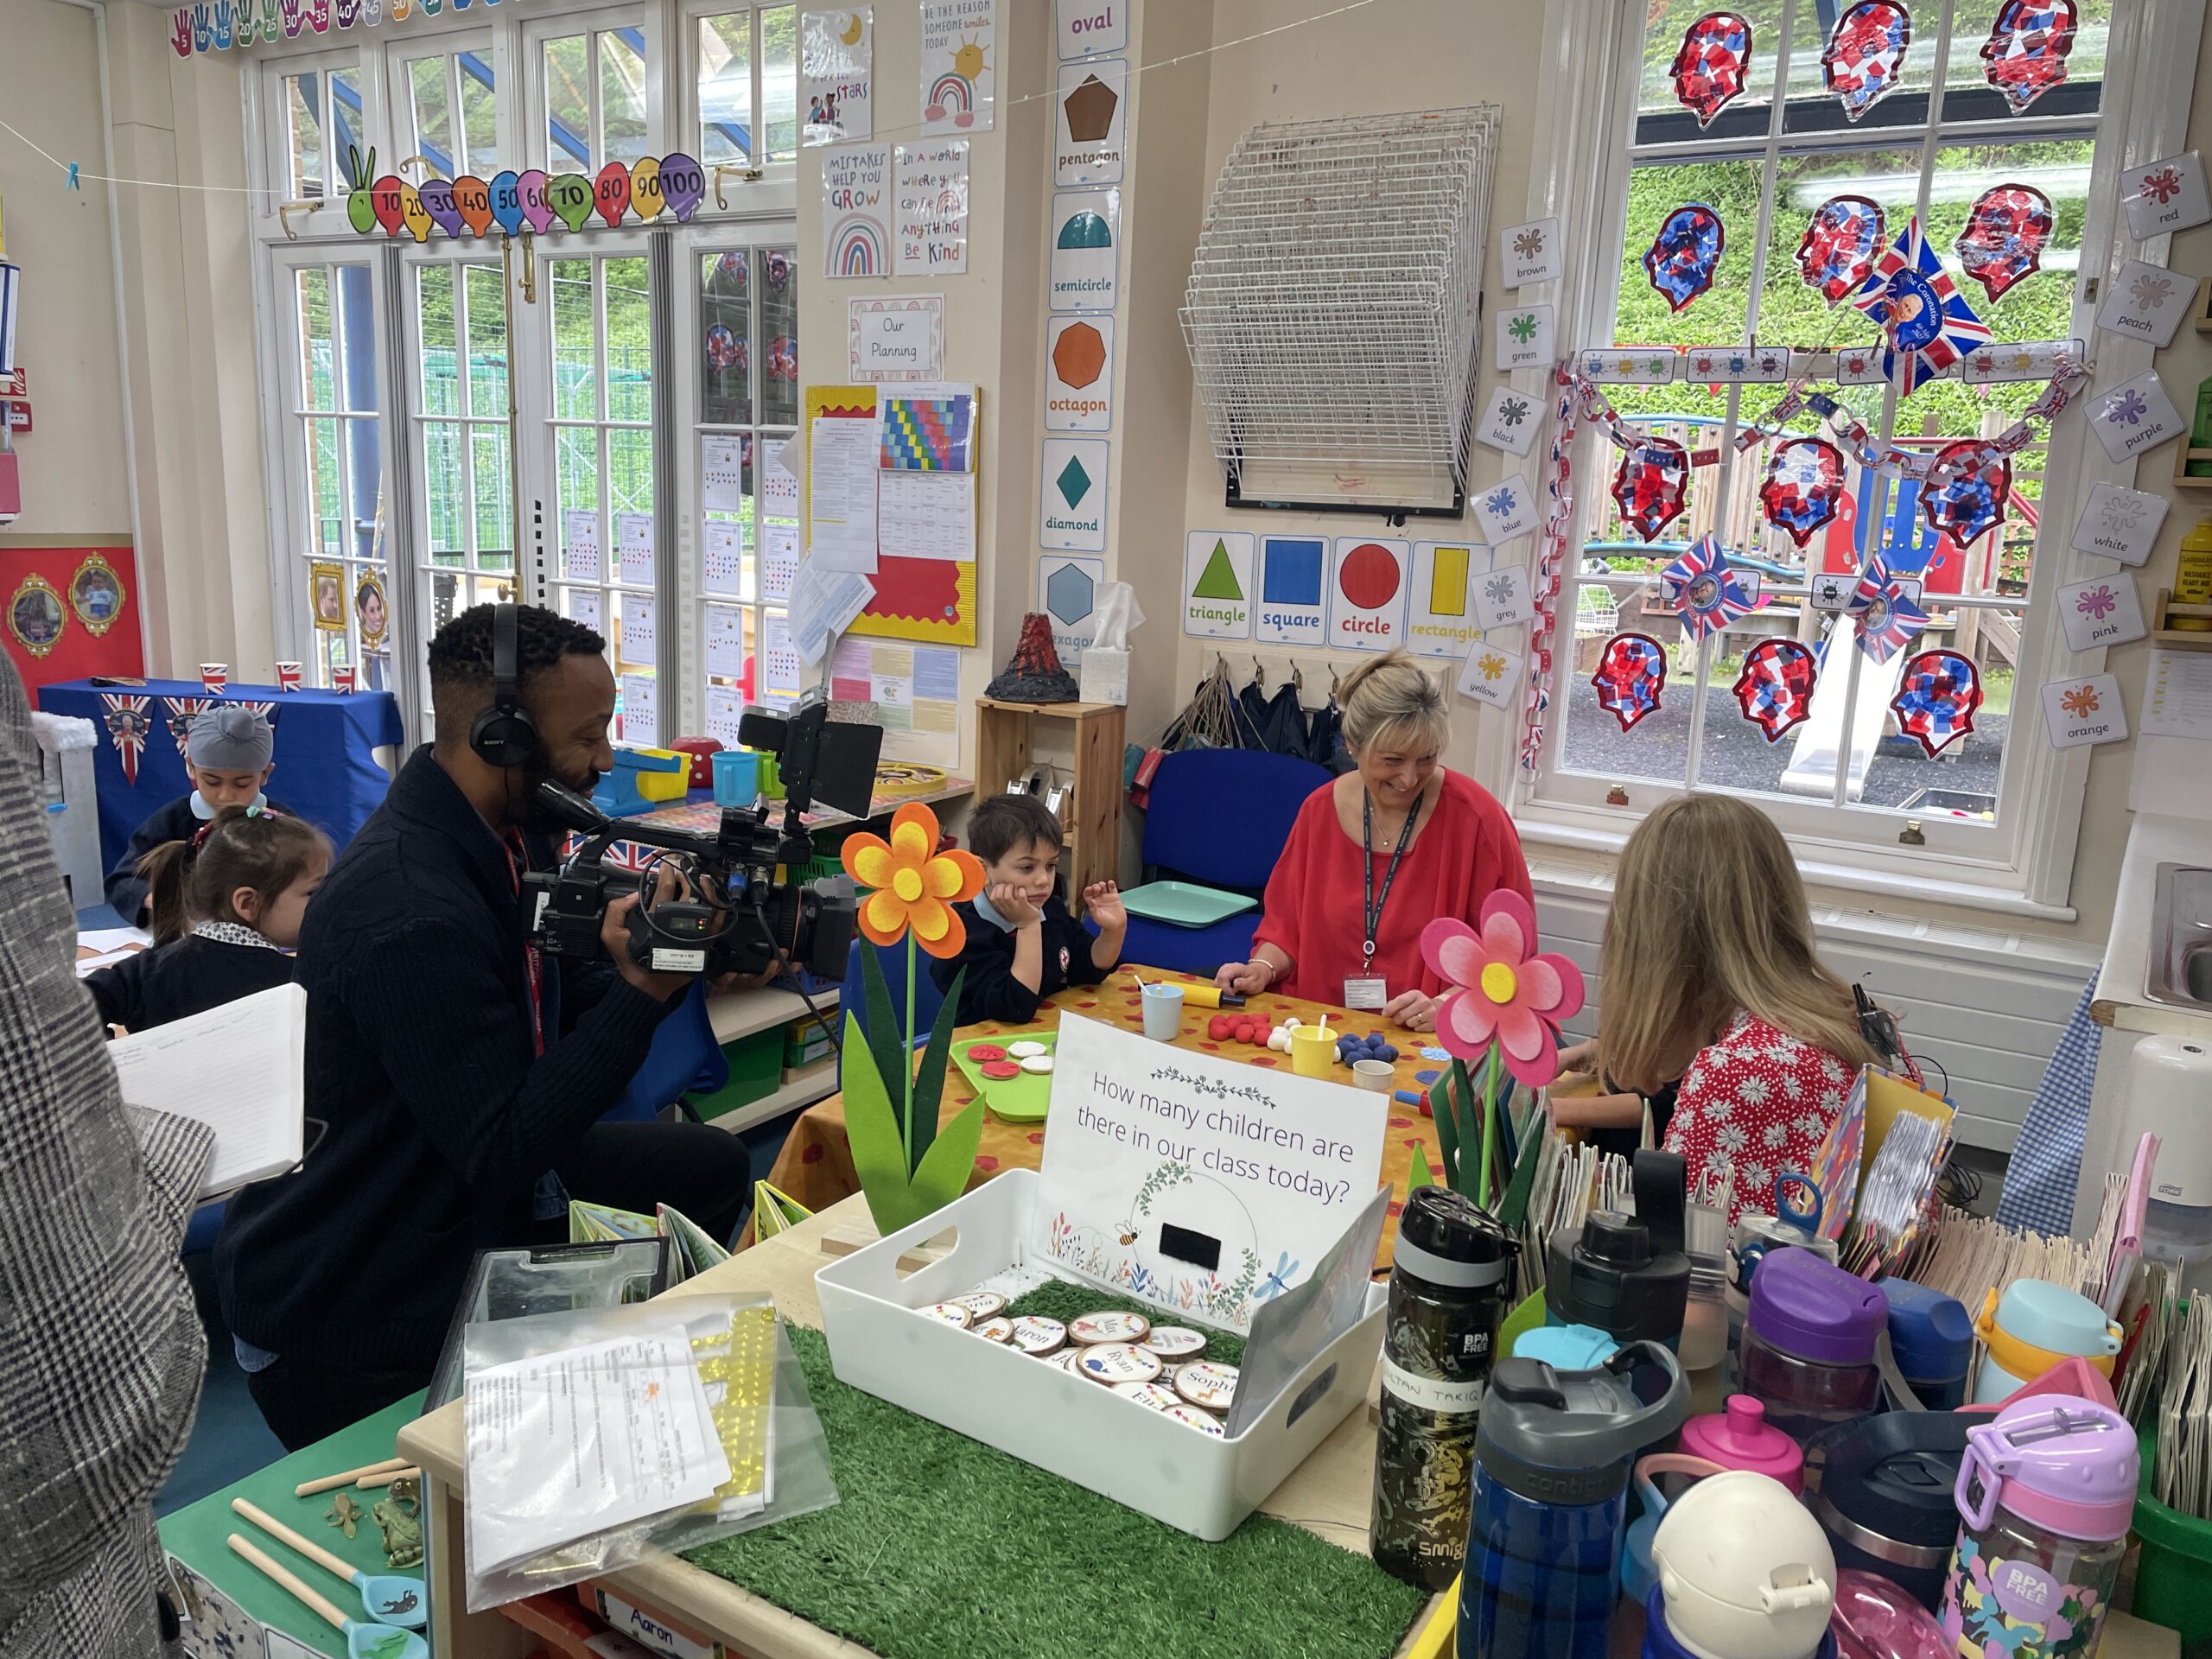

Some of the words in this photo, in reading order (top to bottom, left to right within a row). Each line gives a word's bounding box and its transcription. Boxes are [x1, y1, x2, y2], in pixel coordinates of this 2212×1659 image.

[315, 11, 327, 24] 35
[338, 5, 351, 19] 40
[938, 5, 953, 17] THE
[957, 0, 989, 14] REASON
[238, 22, 251, 36] 20
[265, 18, 277, 32] 25
[284, 15, 297, 29] 30
[925, 19, 963, 35] SOMEONE
[963, 16, 990, 29] smiles
[1071, 7, 1113, 34] oval
[196, 30, 207, 43] 10
[219, 26, 230, 40] 15
[925, 36, 949, 49] TODAY
[181, 38, 188, 48] 5
[917, 153, 925, 162] A
[1059, 150, 1120, 171] pentagon
[637, 175, 659, 197] 90
[662, 171, 702, 194] 100
[832, 171, 856, 186] HELP
[861, 171, 881, 183] YOU
[526, 187, 544, 207] 60
[557, 184, 584, 206] 70
[600, 178, 622, 199] 80
[382, 192, 399, 211] 10
[406, 197, 424, 217] 20
[433, 193, 456, 212] 30
[463, 192, 487, 211] 40
[499, 189, 518, 209] 50
[832, 189, 880, 210] GROW
[2158, 209, 2179, 223] red
[1516, 264, 1547, 277] brown
[1054, 278, 1112, 292] semicircle
[1906, 272, 1917, 286] The
[1917, 283, 1938, 326] Coronation
[883, 317, 905, 332] Our
[2117, 315, 2153, 332] peach
[871, 342, 917, 362] Planning
[1511, 350, 1537, 363] green
[1050, 397, 1107, 416] octagon
[1492, 429, 1516, 445] black
[2125, 423, 2164, 449] purple
[1046, 518, 1098, 532] diamond
[1502, 519, 1522, 533] blue
[2094, 536, 2128, 552] white
[1190, 605, 1245, 626] triangle
[1263, 612, 1319, 632] square
[1496, 609, 1516, 621] grey
[1342, 616, 1391, 635] circle
[1411, 623, 1481, 643] rectangle
[2092, 624, 2119, 640] pink
[1469, 683, 1498, 698] yellow
[2068, 723, 2109, 738] orange
[1093, 1071, 1135, 1105] How
[1140, 1090, 1200, 1130] many
[1206, 1109, 1305, 1151] children
[1313, 1139, 1354, 1163] are
[1077, 1106, 1126, 1141] there
[1132, 1125, 1149, 1150] in
[1157, 1139, 1196, 1163] our
[1203, 1148, 1261, 1180] class
[1268, 1164, 1351, 1205] today?
[1465, 1332, 1489, 1344] BPA
[1464, 1344, 1488, 1354] FREE
[1108, 1351, 1134, 1372] Ryan
[1187, 1371, 1235, 1393] Sophi
[2010, 1568, 2048, 1596] BPA
[2006, 1580, 2047, 1605] FREE
[631, 1609, 673, 1646] Aaron
